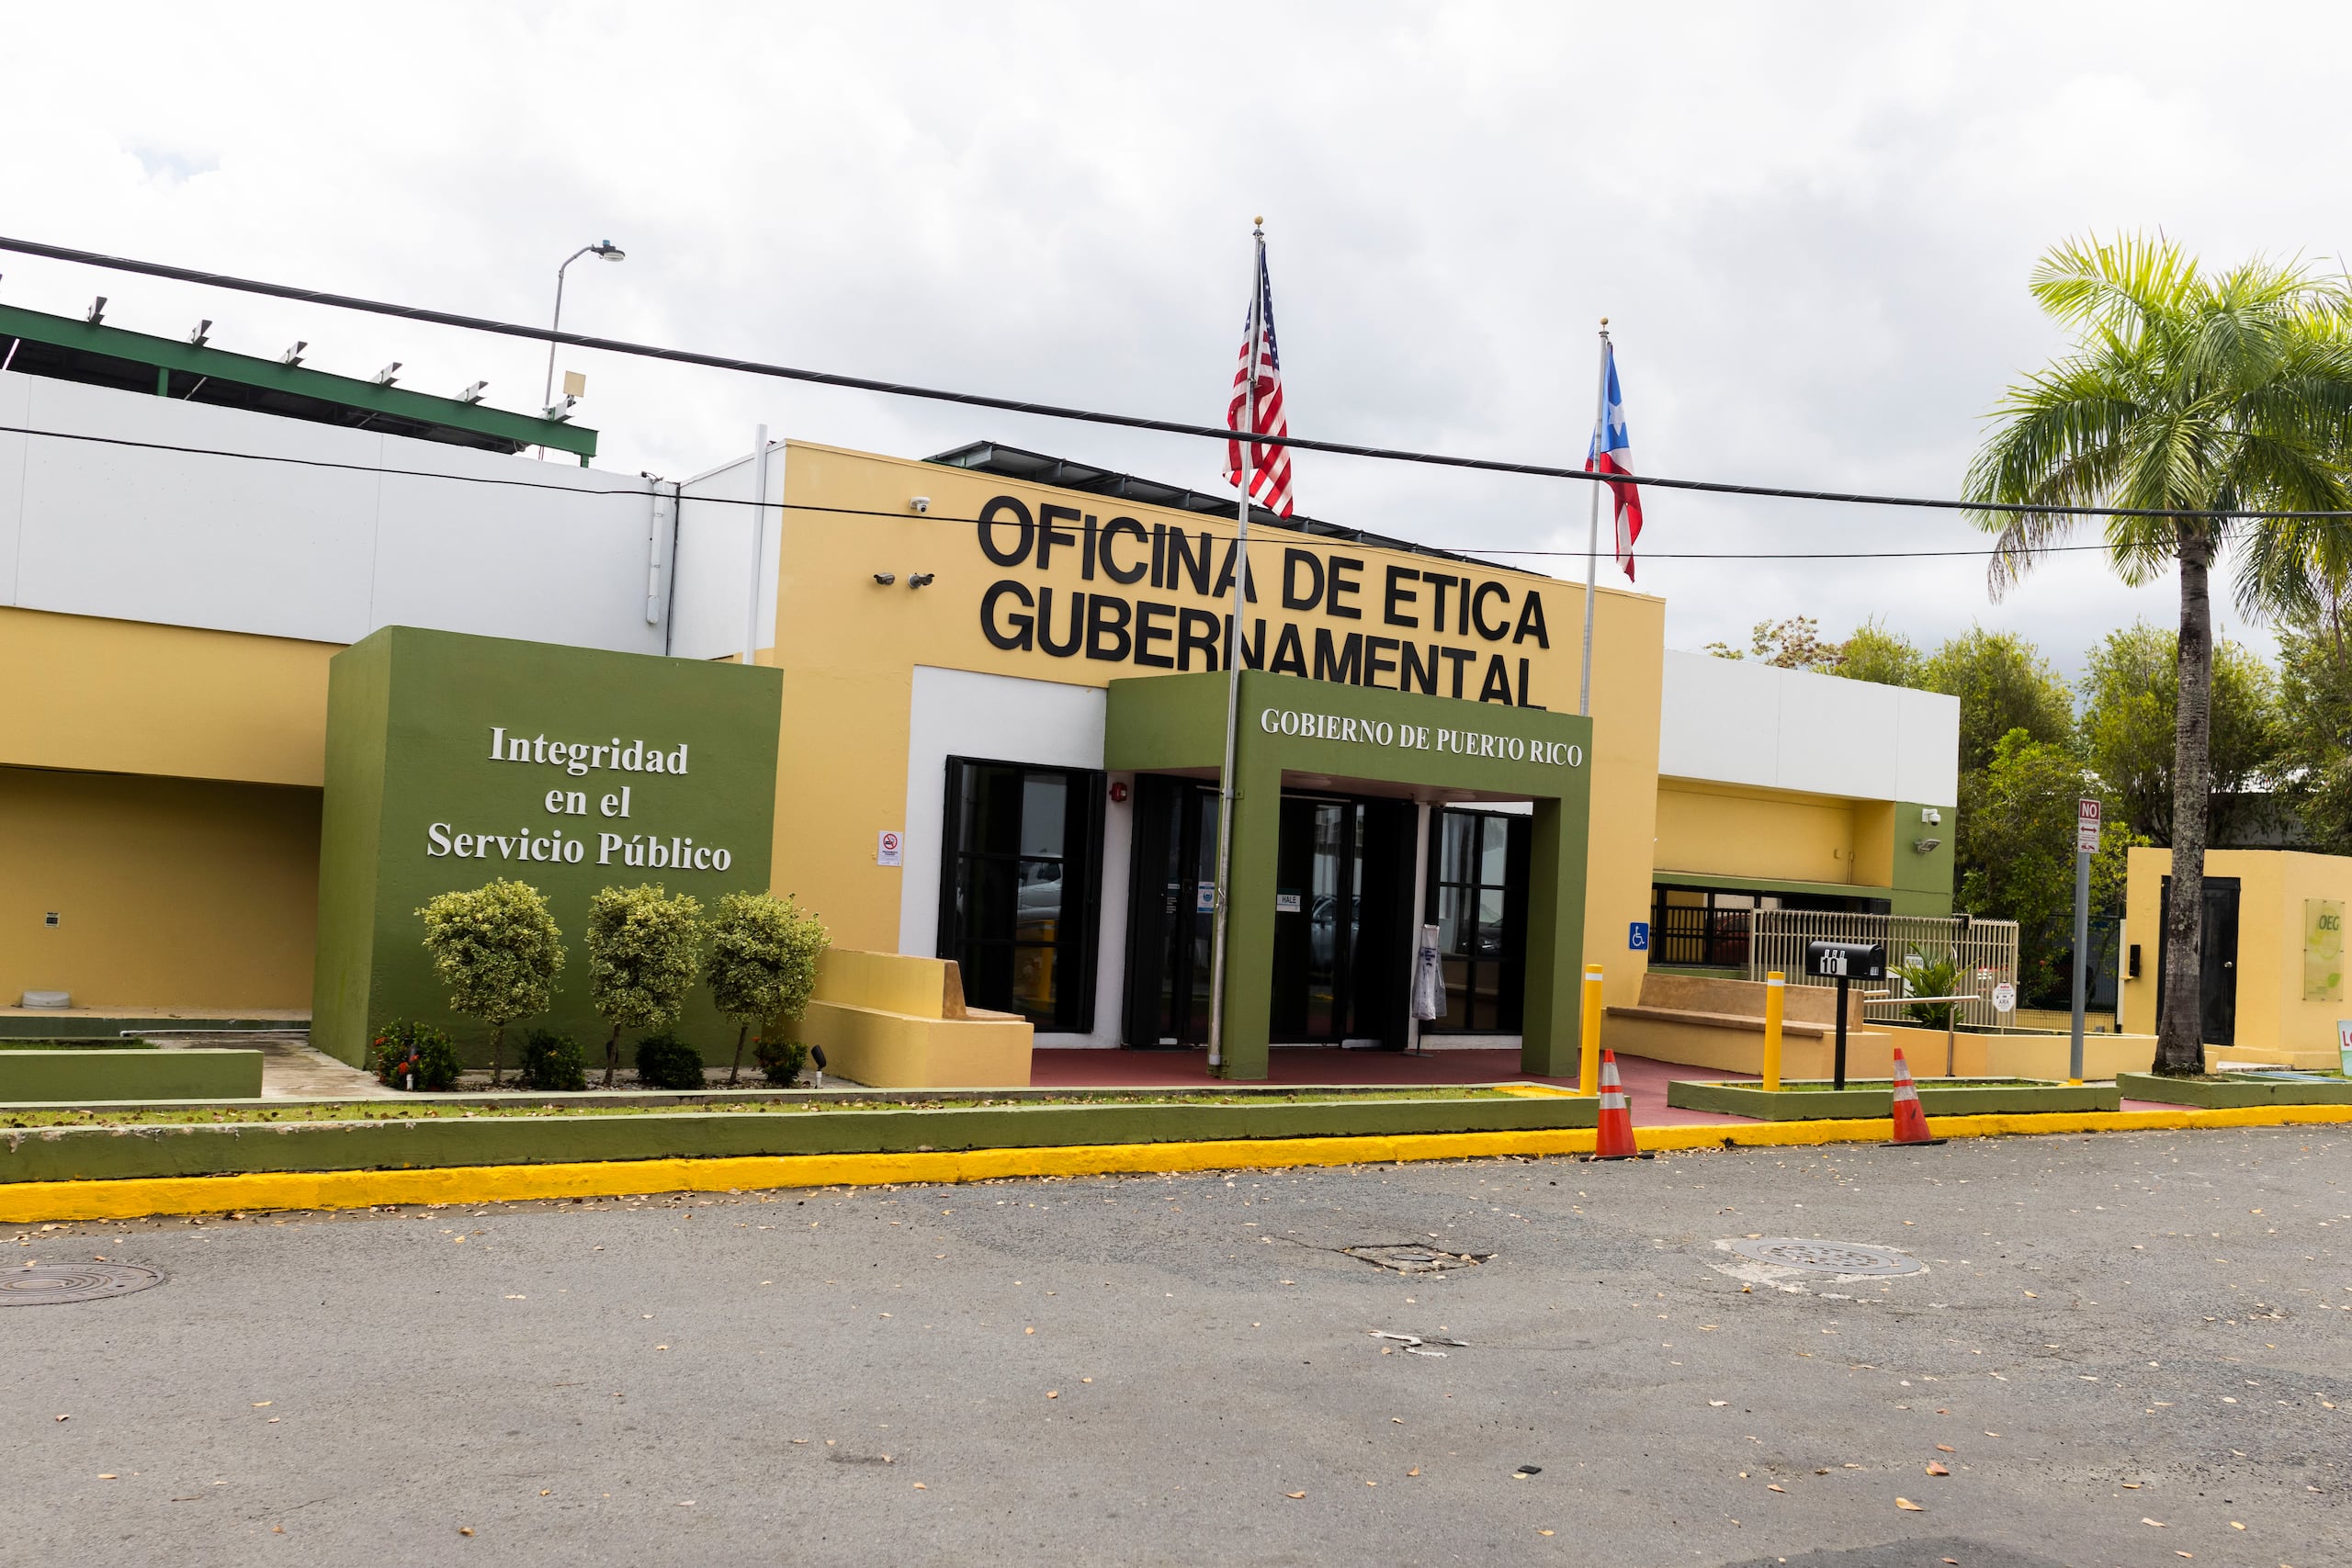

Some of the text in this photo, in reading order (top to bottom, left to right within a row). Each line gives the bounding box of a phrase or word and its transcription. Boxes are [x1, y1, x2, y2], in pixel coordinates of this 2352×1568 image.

[978, 495, 1550, 649] OFICINA DE ETICA
[980, 580, 1546, 711] GUBERNAMENTAL
[488, 727, 689, 776] Integridad
[1261, 708, 1583, 768] GOBIERNO DE PUERTO RICO
[545, 785, 631, 818] en el
[2082, 803, 2098, 818] NO
[426, 823, 731, 872] Servicio Público
[2318, 915, 2340, 931] OEG
